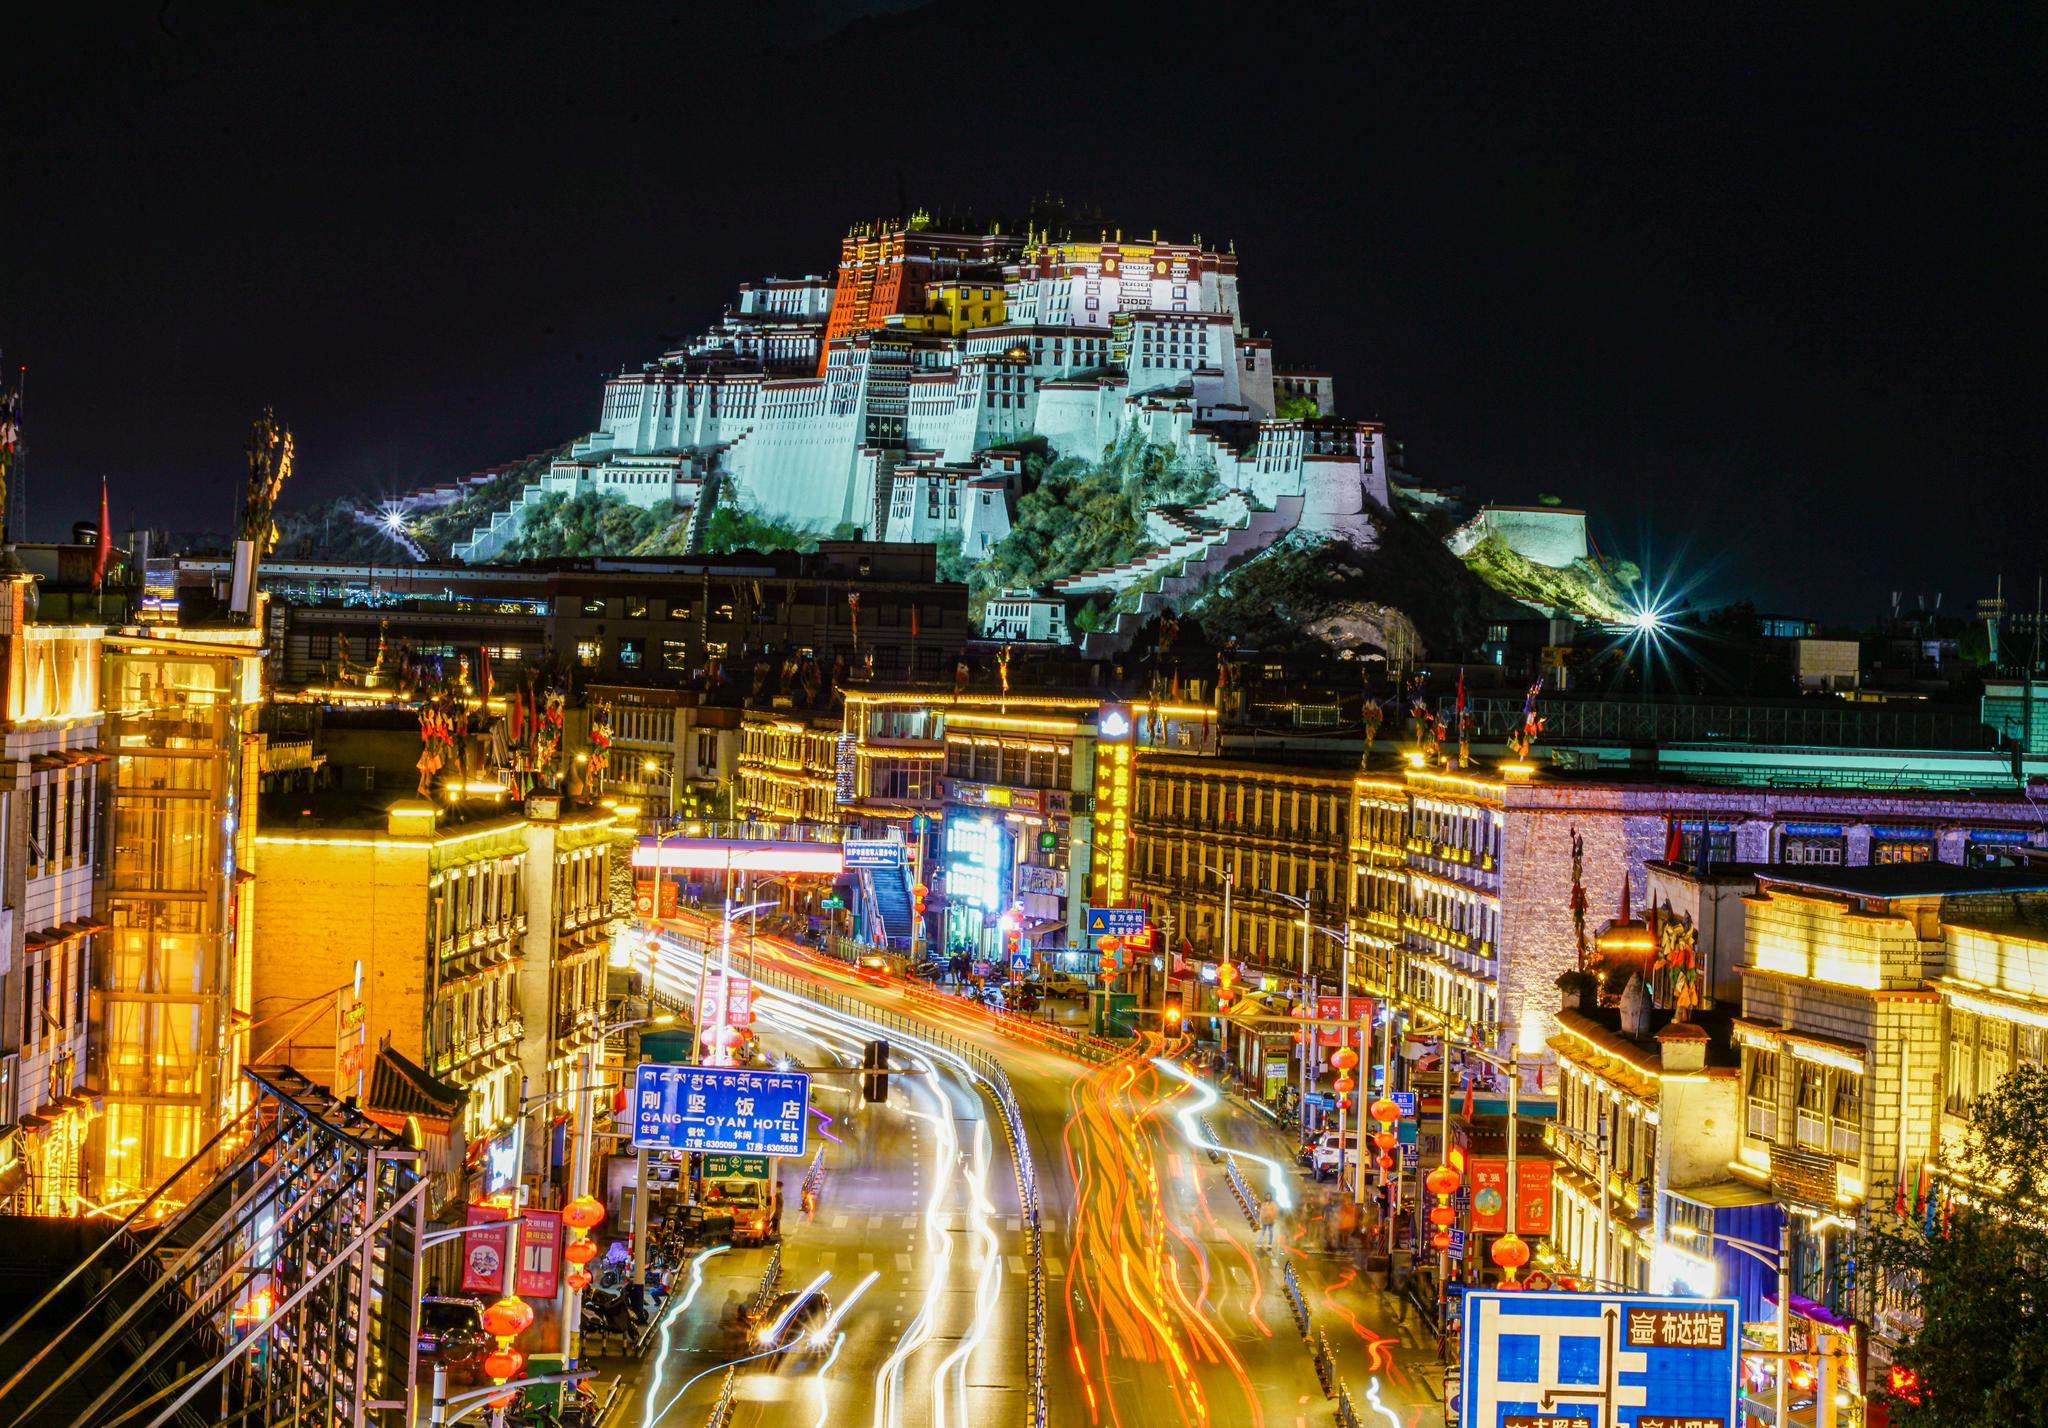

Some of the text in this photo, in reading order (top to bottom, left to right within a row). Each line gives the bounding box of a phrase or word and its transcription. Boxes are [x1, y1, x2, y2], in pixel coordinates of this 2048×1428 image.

[1109, 914, 1142, 923] 前方学校
[1109, 927, 1141, 936] 注意安全
[641, 1090, 800, 1120] 刚坚饭店
[753, 1118, 799, 1131] HOTEL
[640, 1124, 799, 1143] 住宿 餐饮 休闲 观景
[1661, 1312, 1724, 1346] 布达拉宫
